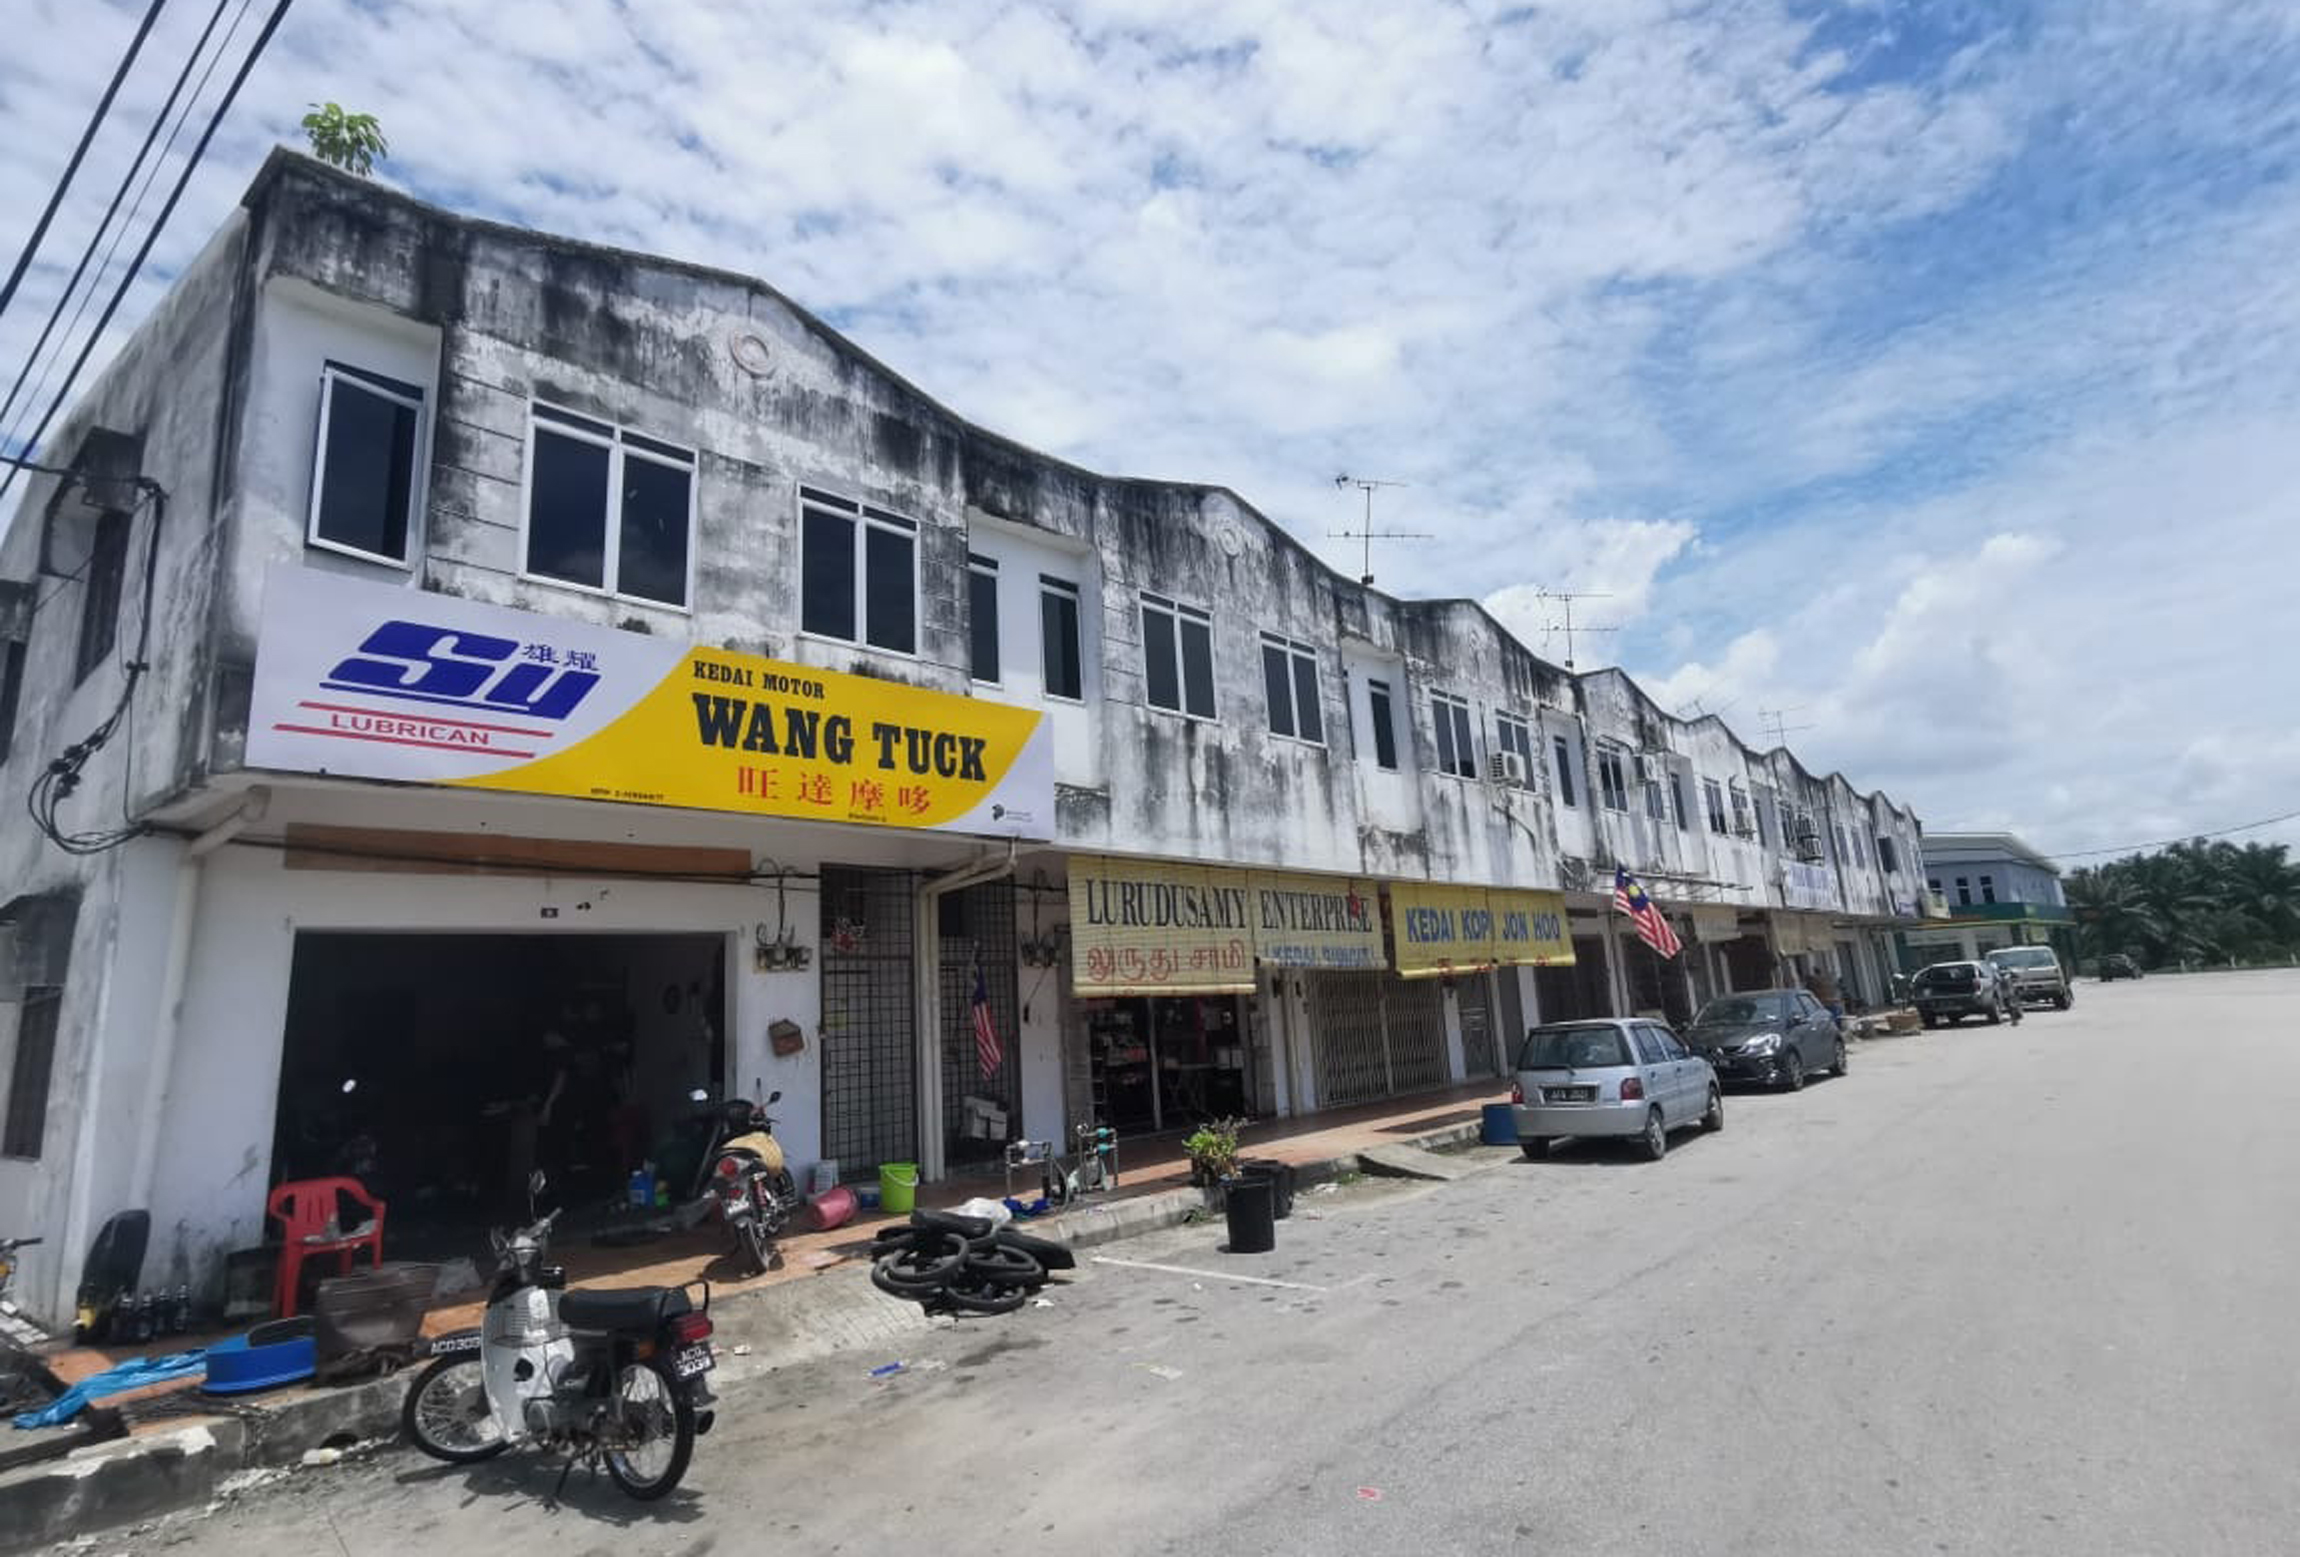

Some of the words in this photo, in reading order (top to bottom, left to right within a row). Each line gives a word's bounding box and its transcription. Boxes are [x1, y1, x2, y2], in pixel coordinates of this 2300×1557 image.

[693, 660, 753, 687] KEDAI
[763, 673, 825, 699] MOTOR
[331, 711, 490, 746] LUBRICAN
[691, 692, 855, 765] WANG
[871, 722, 987, 782] TUCK
[1086, 878, 1247, 929] LURUDUSAMY
[1405, 907, 1456, 943] KEDAI
[1460, 908, 1495, 942] KOPI
[1502, 911, 1529, 942] JON
[1532, 911, 1560, 941] HOO
